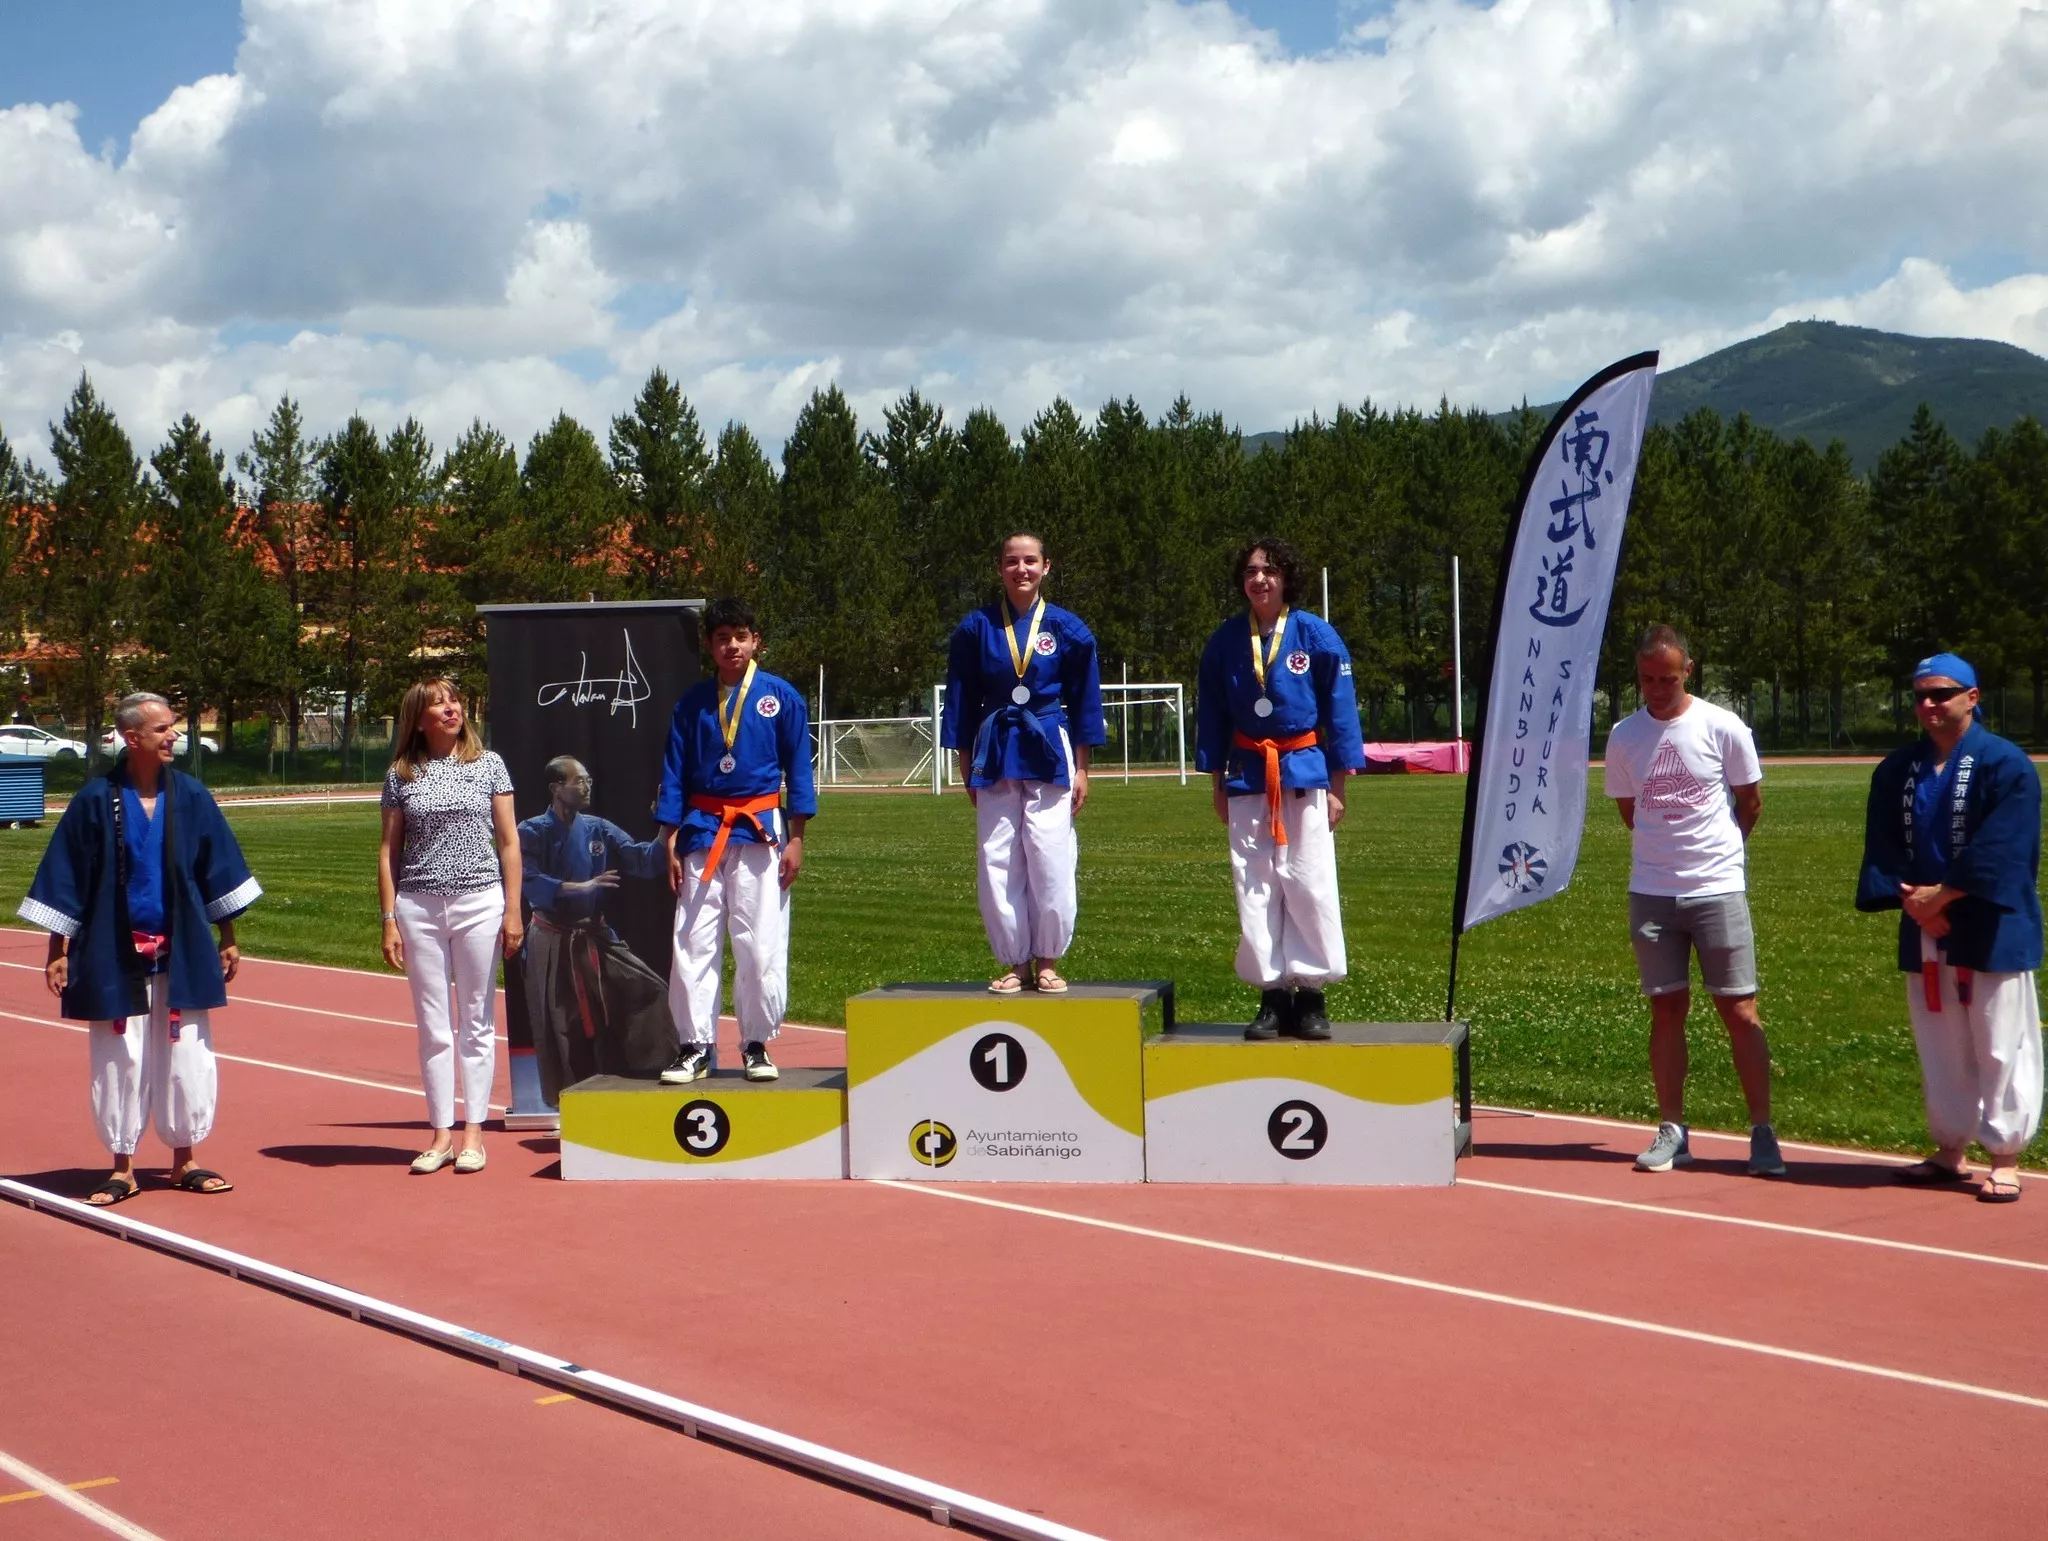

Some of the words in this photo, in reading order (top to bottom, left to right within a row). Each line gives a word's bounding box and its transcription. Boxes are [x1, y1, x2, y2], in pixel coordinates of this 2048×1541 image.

[1529, 410, 1613, 627] 南武道
[1505, 637, 1541, 821] NANBUDO
[1532, 660, 1572, 815] SAKURA
[984, 1042, 1009, 1083] 1
[686, 1108, 719, 1149] 3
[966, 1129, 1078, 1143] Ayuntamiento
[1281, 1108, 1315, 1150] 2
